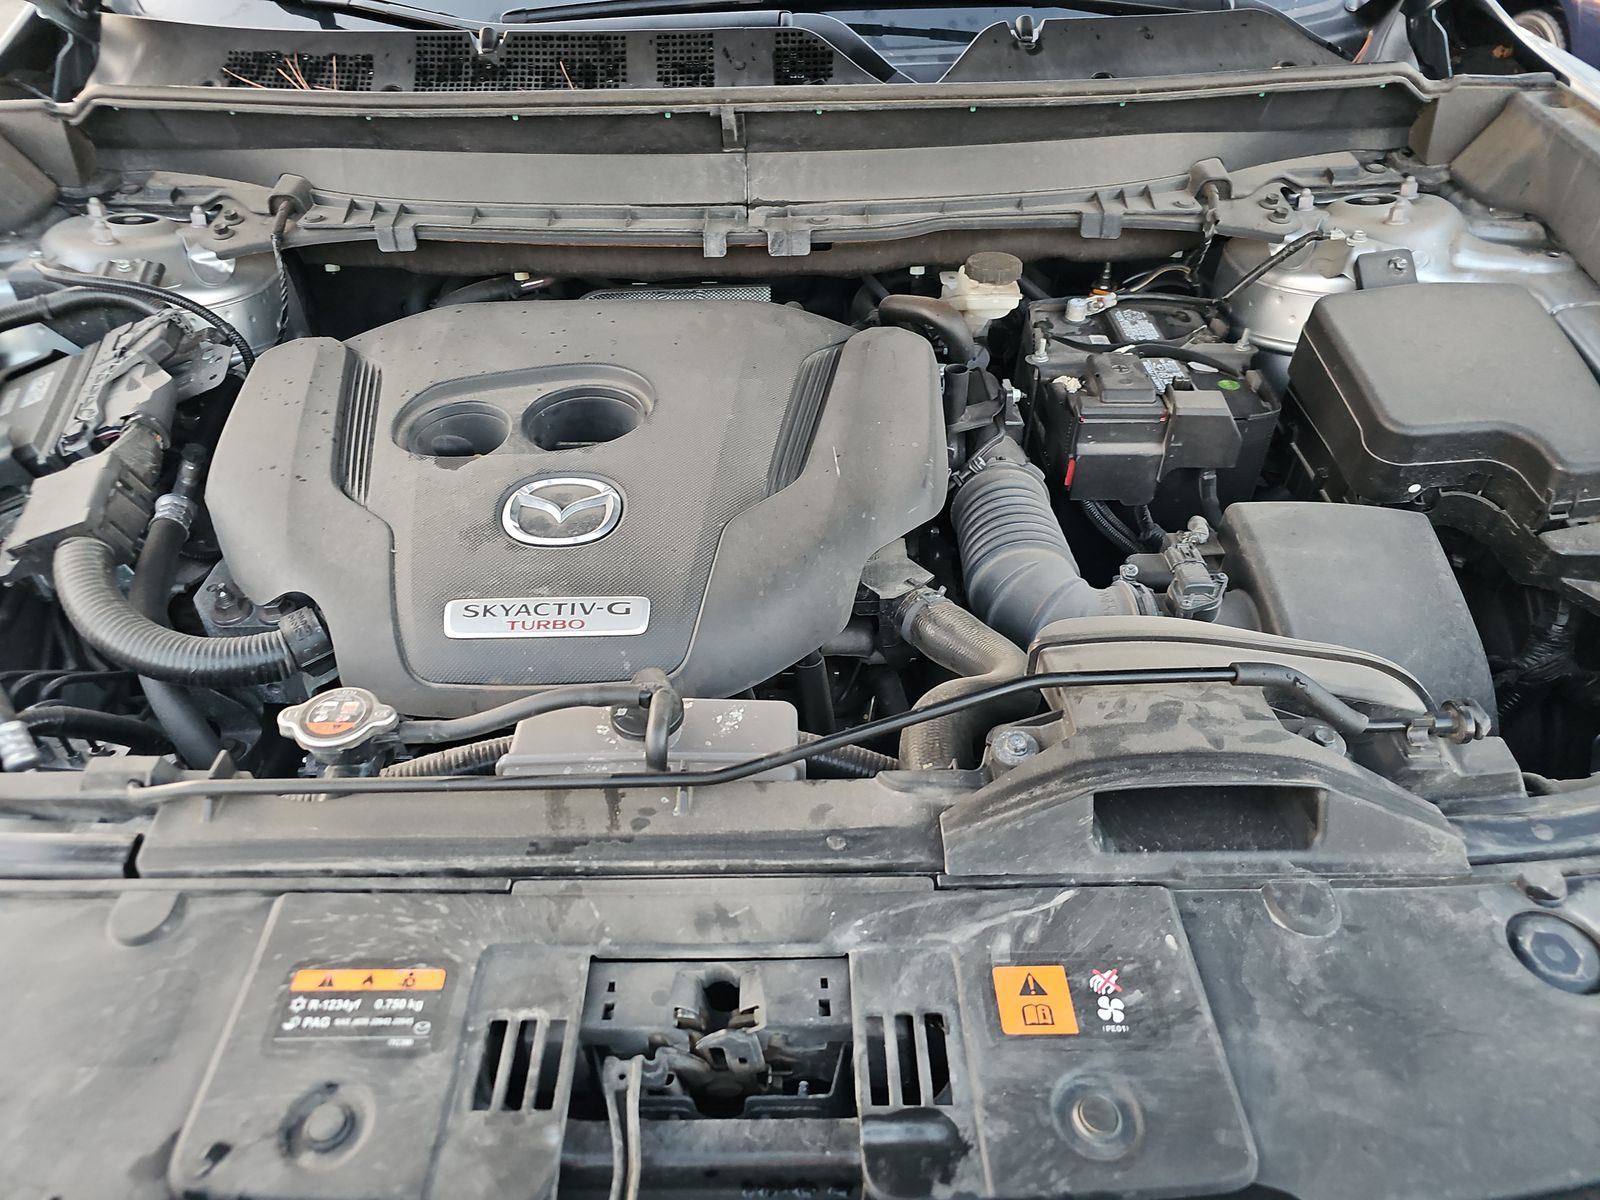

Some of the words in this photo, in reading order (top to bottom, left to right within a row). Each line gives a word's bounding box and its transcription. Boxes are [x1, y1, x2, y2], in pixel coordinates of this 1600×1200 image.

[462, 601, 632, 618] SKYACTIV-G
[506, 618, 586, 631] TURBO
[407, 998, 424, 1013] kg
